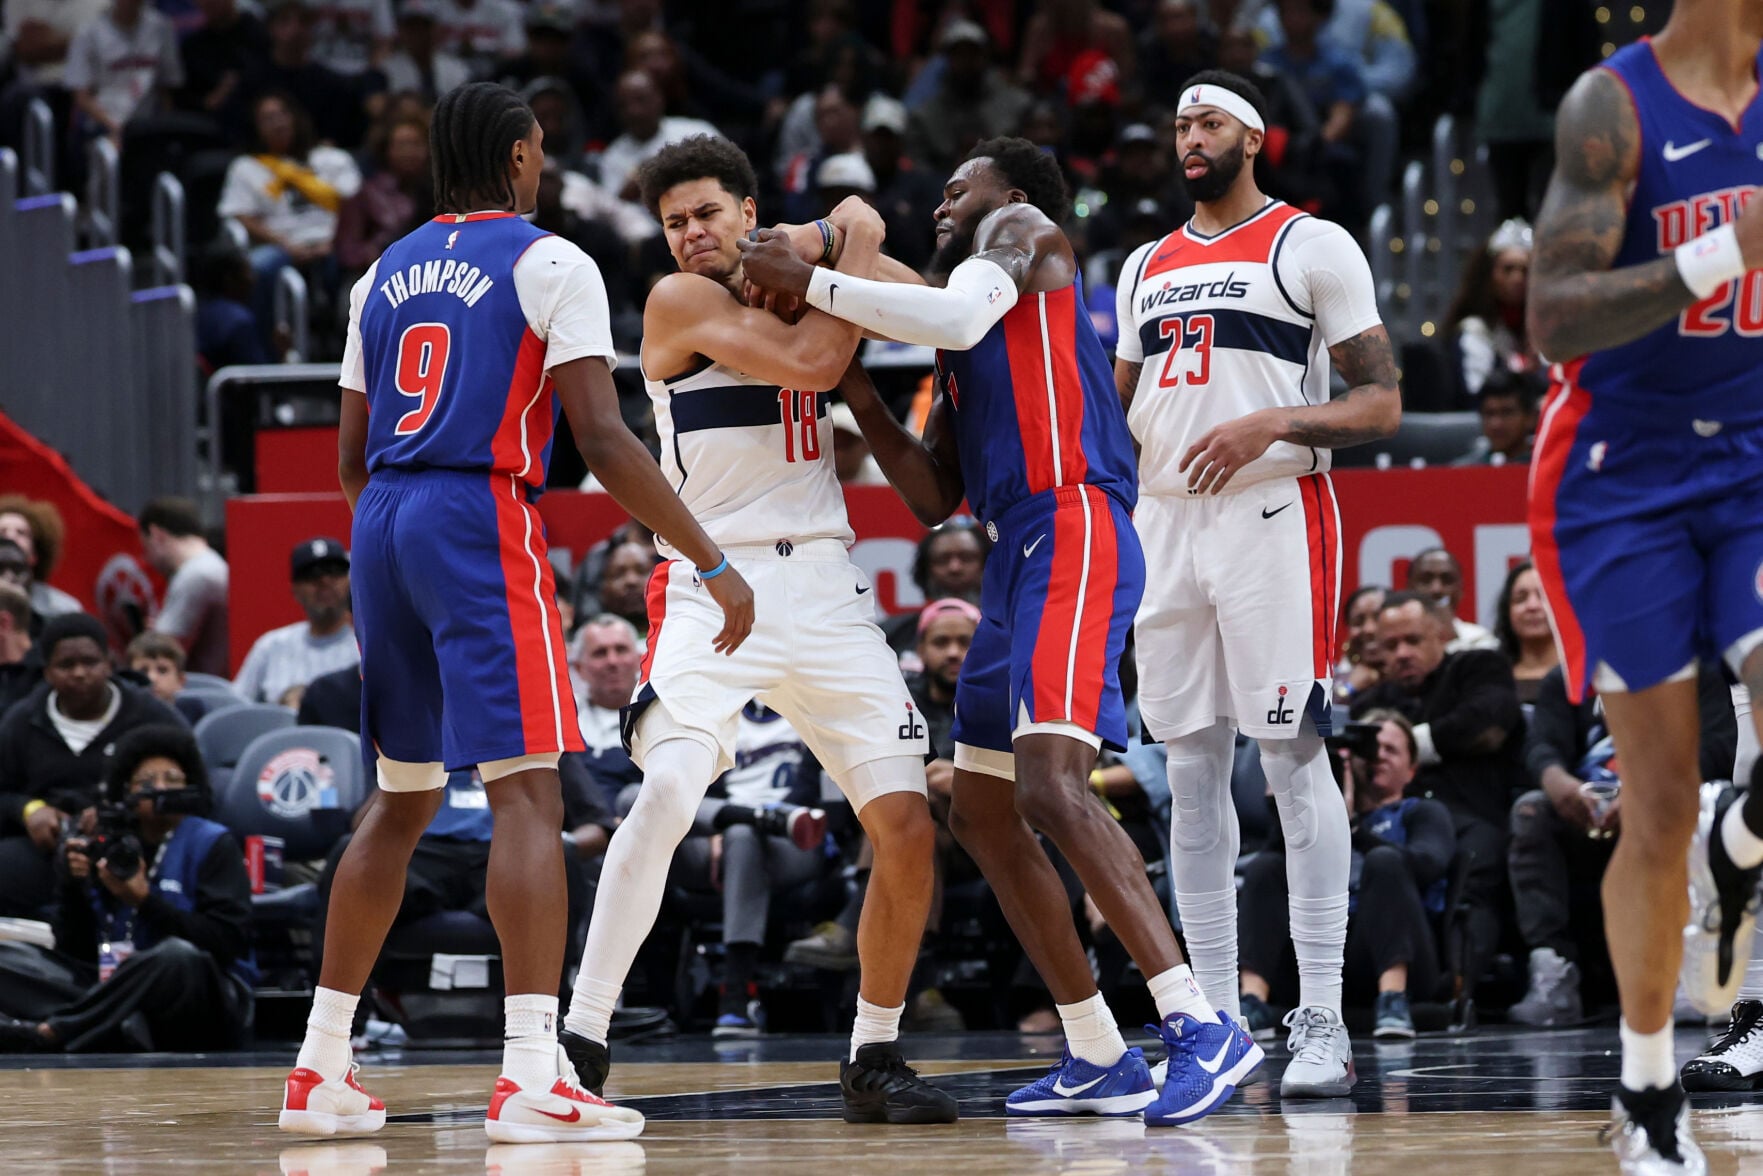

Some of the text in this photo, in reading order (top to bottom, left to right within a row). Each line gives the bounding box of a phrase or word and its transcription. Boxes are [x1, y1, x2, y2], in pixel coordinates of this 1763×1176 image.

[1651, 184, 1757, 253] DET
[380, 259, 493, 309] THOMPSON
[1141, 271, 1251, 314] wizards
[1678, 268, 1763, 337] 20
[394, 322, 450, 436] 9
[1158, 314, 1214, 389] 23
[777, 387, 821, 464] 18
[899, 711, 924, 740] dc
[1267, 696, 1294, 724] dc
